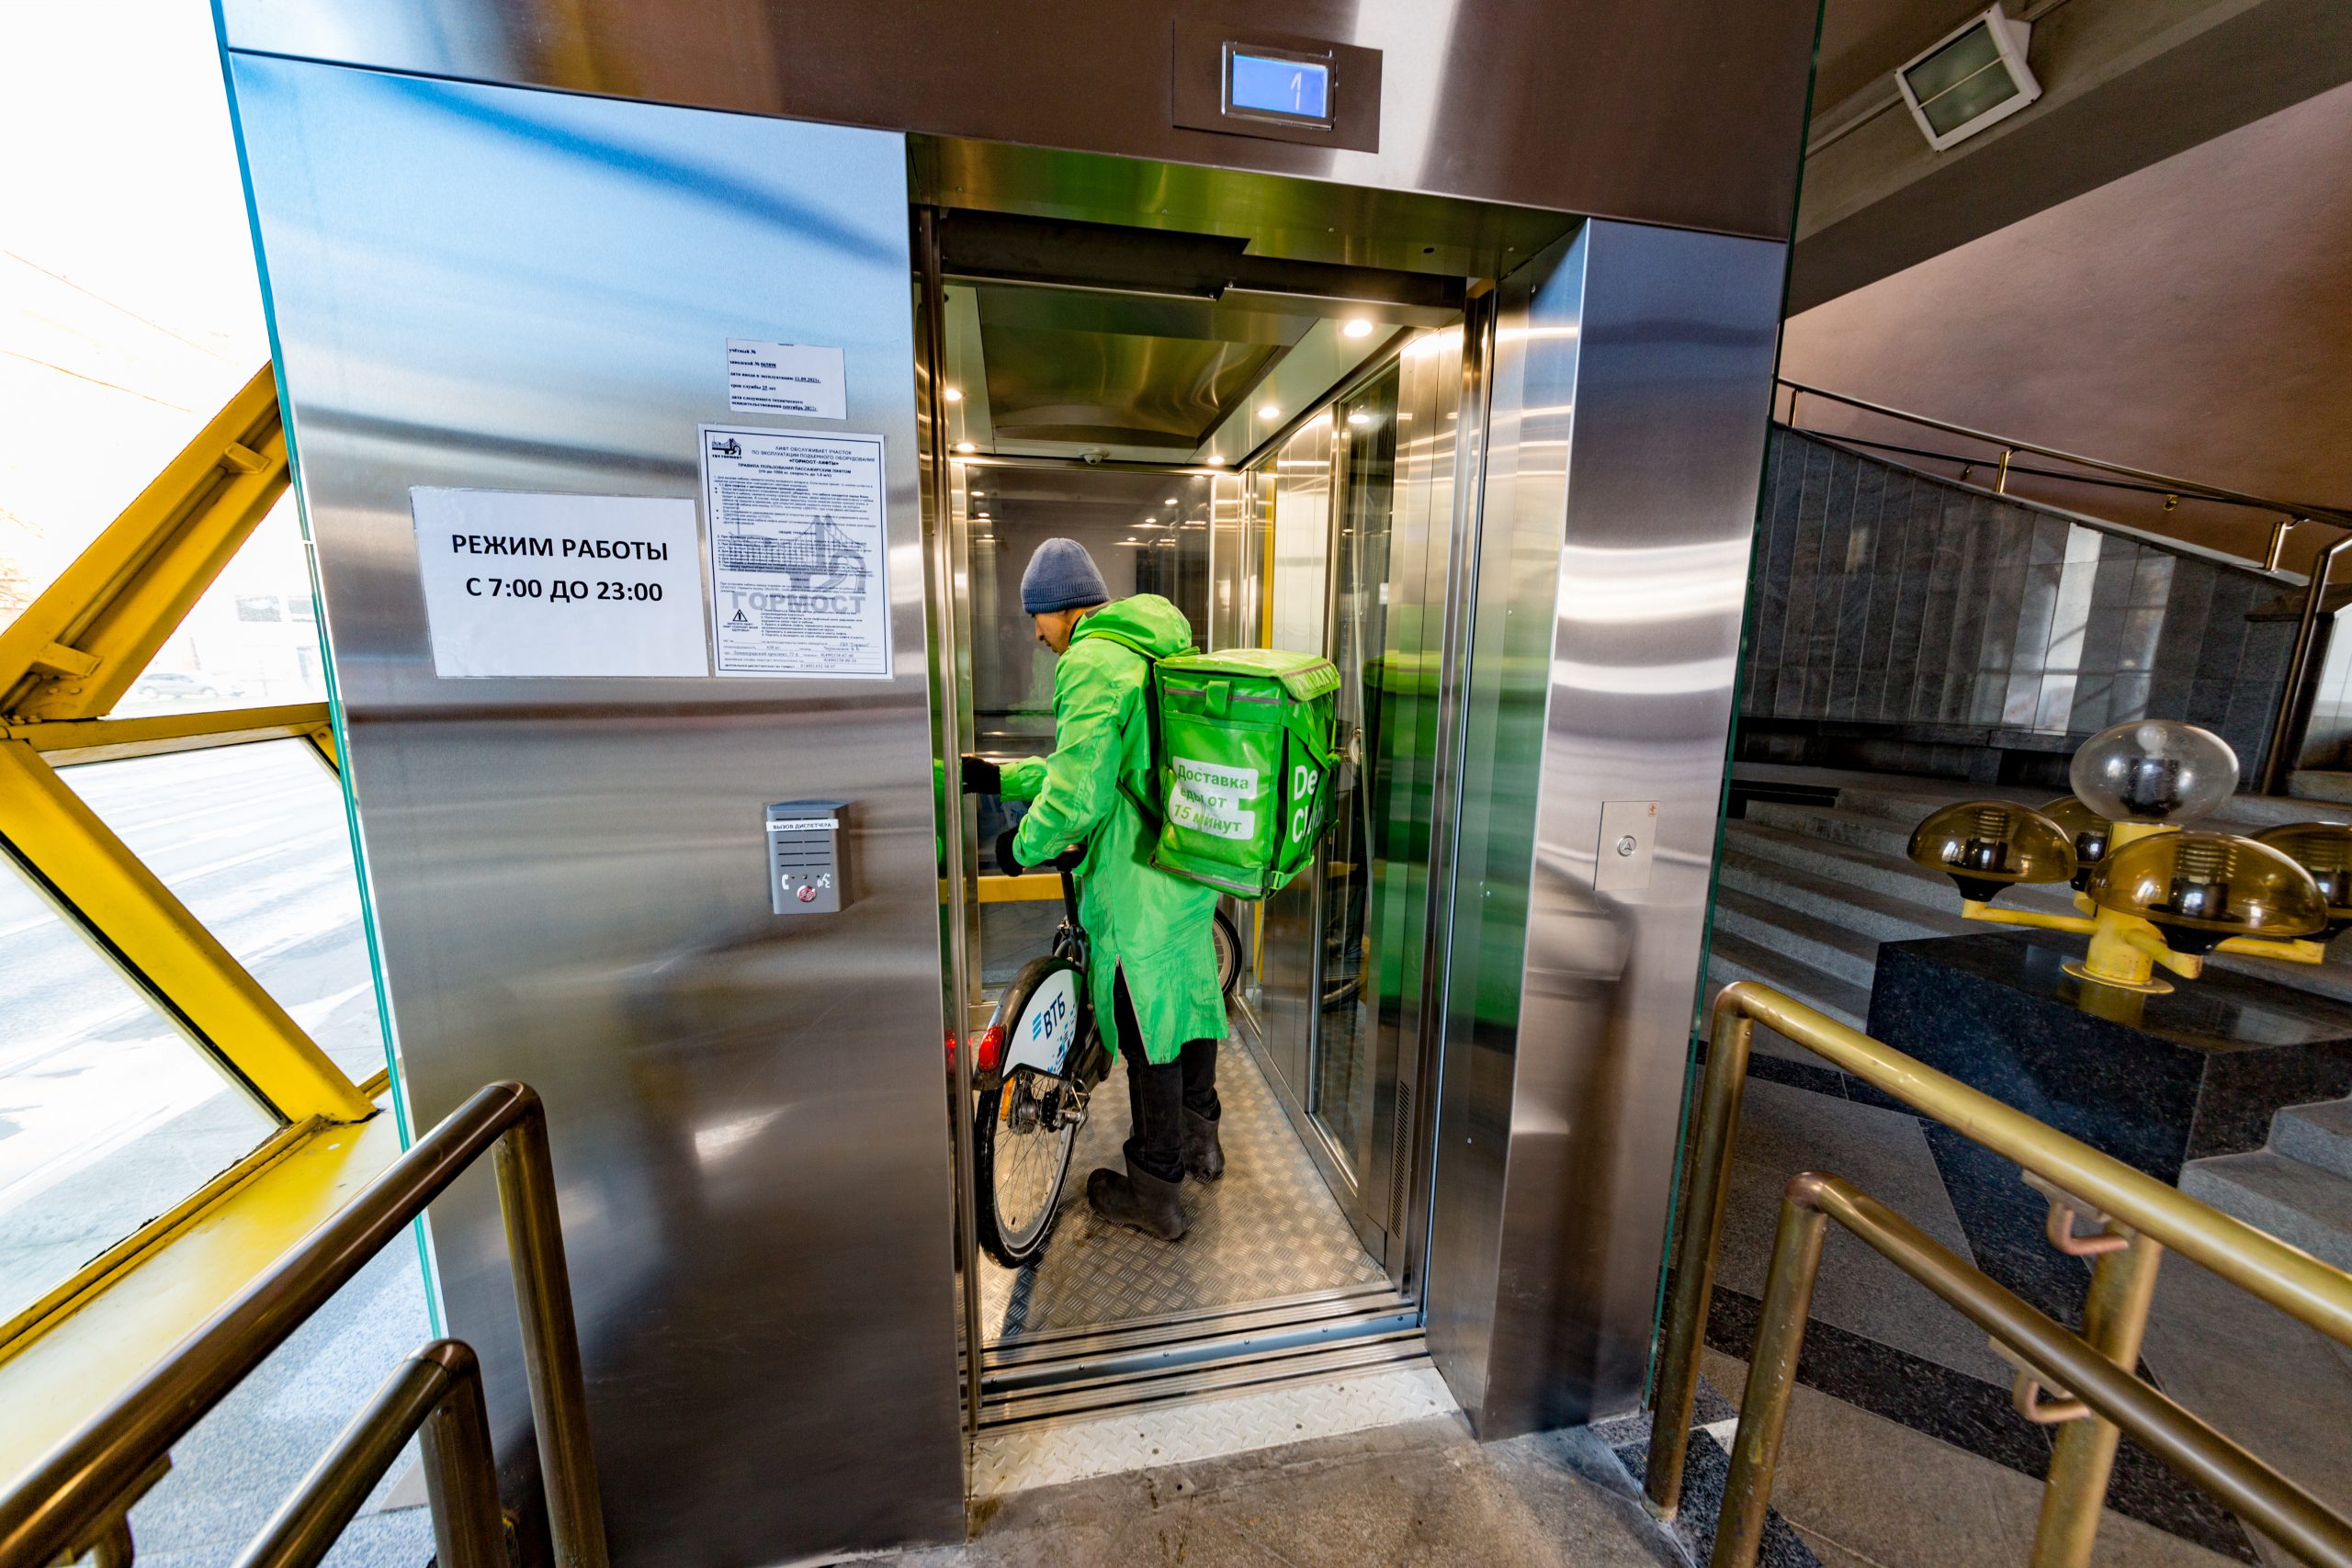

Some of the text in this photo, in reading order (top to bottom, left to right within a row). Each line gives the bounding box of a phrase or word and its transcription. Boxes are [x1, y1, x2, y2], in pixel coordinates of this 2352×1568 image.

[1290, 72, 1302, 111] 1
[451, 534, 668, 560] РЕЖИМ РАБОТЫ
[466, 577, 662, 603] С 7:00 ДО 23:00
[731, 591, 865, 614] ГОРМОСТ
[1177, 764, 1249, 790] Доставка
[1180, 787, 1227, 808] еды от
[1174, 804, 1241, 834] 15 минут
[1043, 990, 1066, 1040] ВТБ
